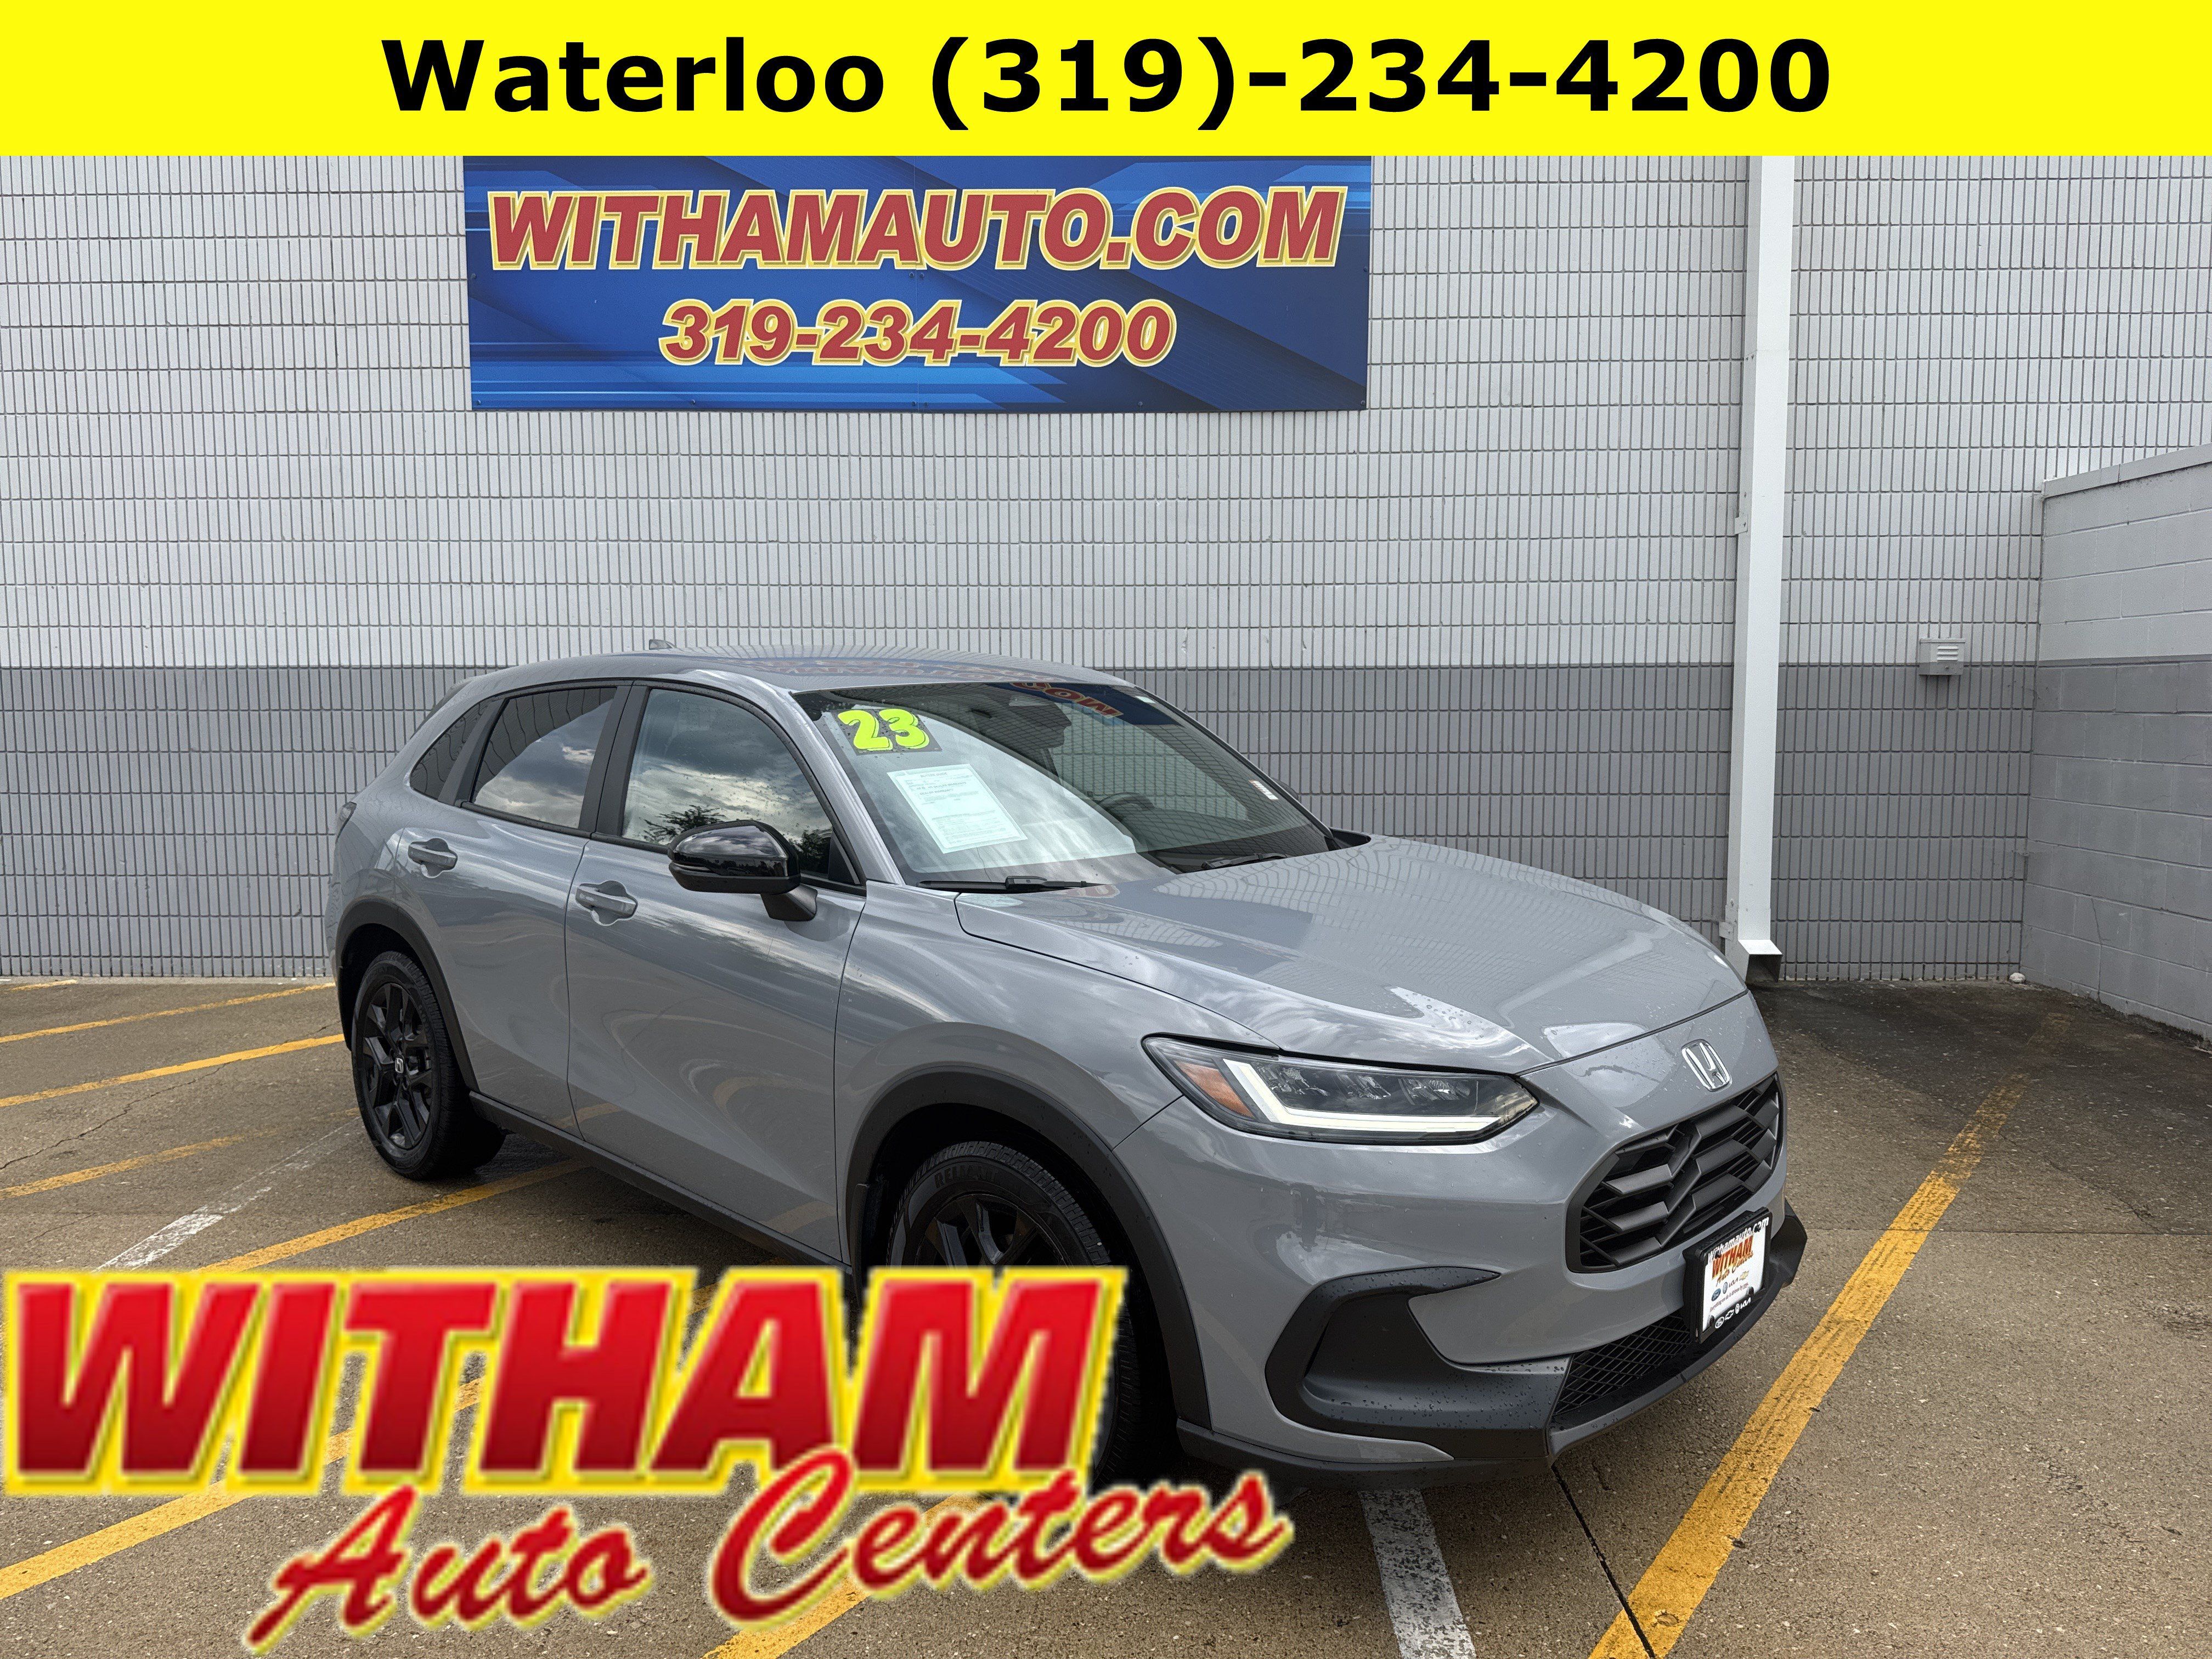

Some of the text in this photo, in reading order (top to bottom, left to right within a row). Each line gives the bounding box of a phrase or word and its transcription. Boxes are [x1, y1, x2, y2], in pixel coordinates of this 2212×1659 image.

[488, 185, 1348, 271] WITHAMAUTO.COM
[659, 298, 1176, 368] 319-234-4200
[838, 708, 930, 752] 23
[1712, 1234, 1753, 1279] WITHAM
